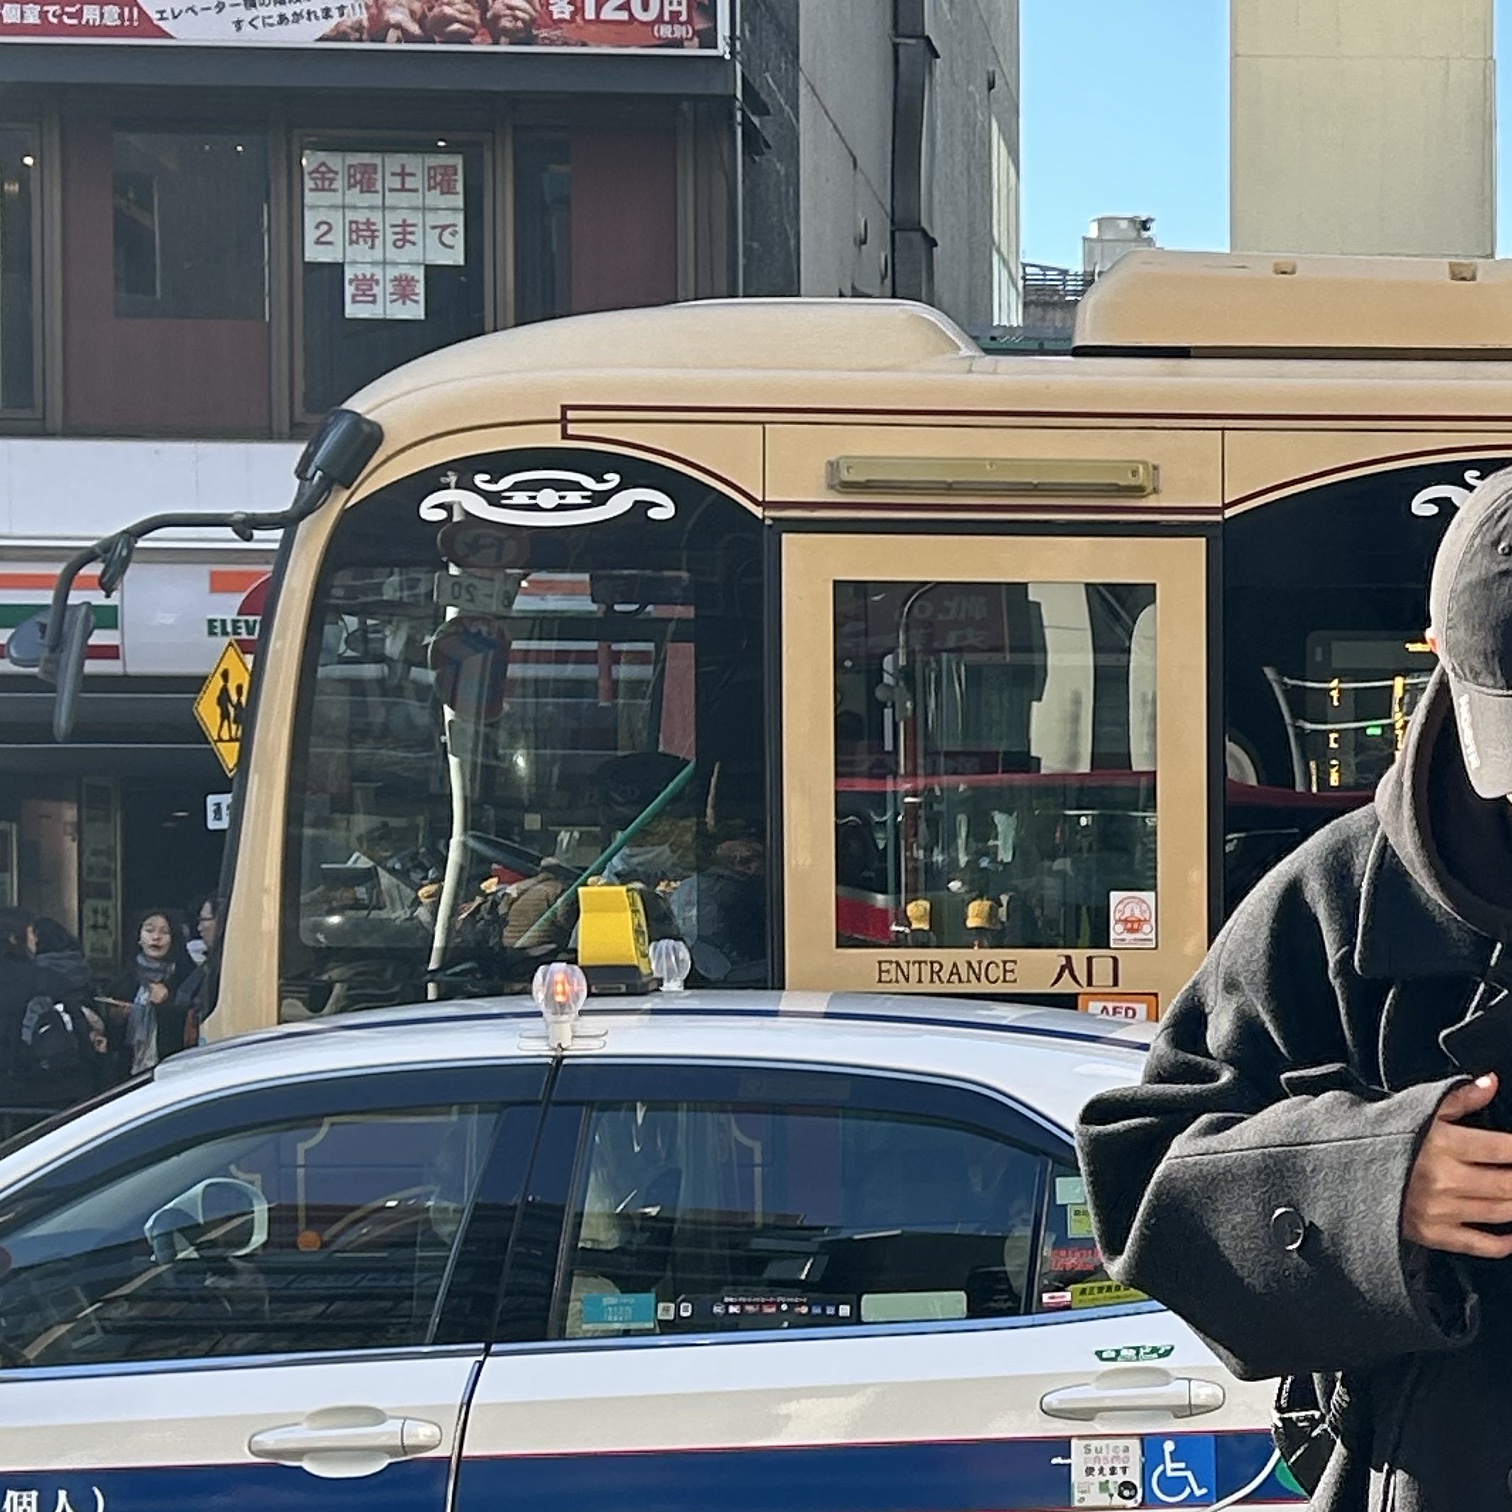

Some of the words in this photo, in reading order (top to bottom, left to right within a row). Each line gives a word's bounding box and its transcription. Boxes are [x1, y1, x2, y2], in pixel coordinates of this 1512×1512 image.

[307, 161, 460, 196] 金曜土曜
[313, 218, 459, 250] 2時まで
[348, 272, 420, 306] 営業
[876, 960, 1018, 984] ENTRANCE
[1049, 954, 1119, 988] 入口
[1100, 1004, 1137, 1019] AED
